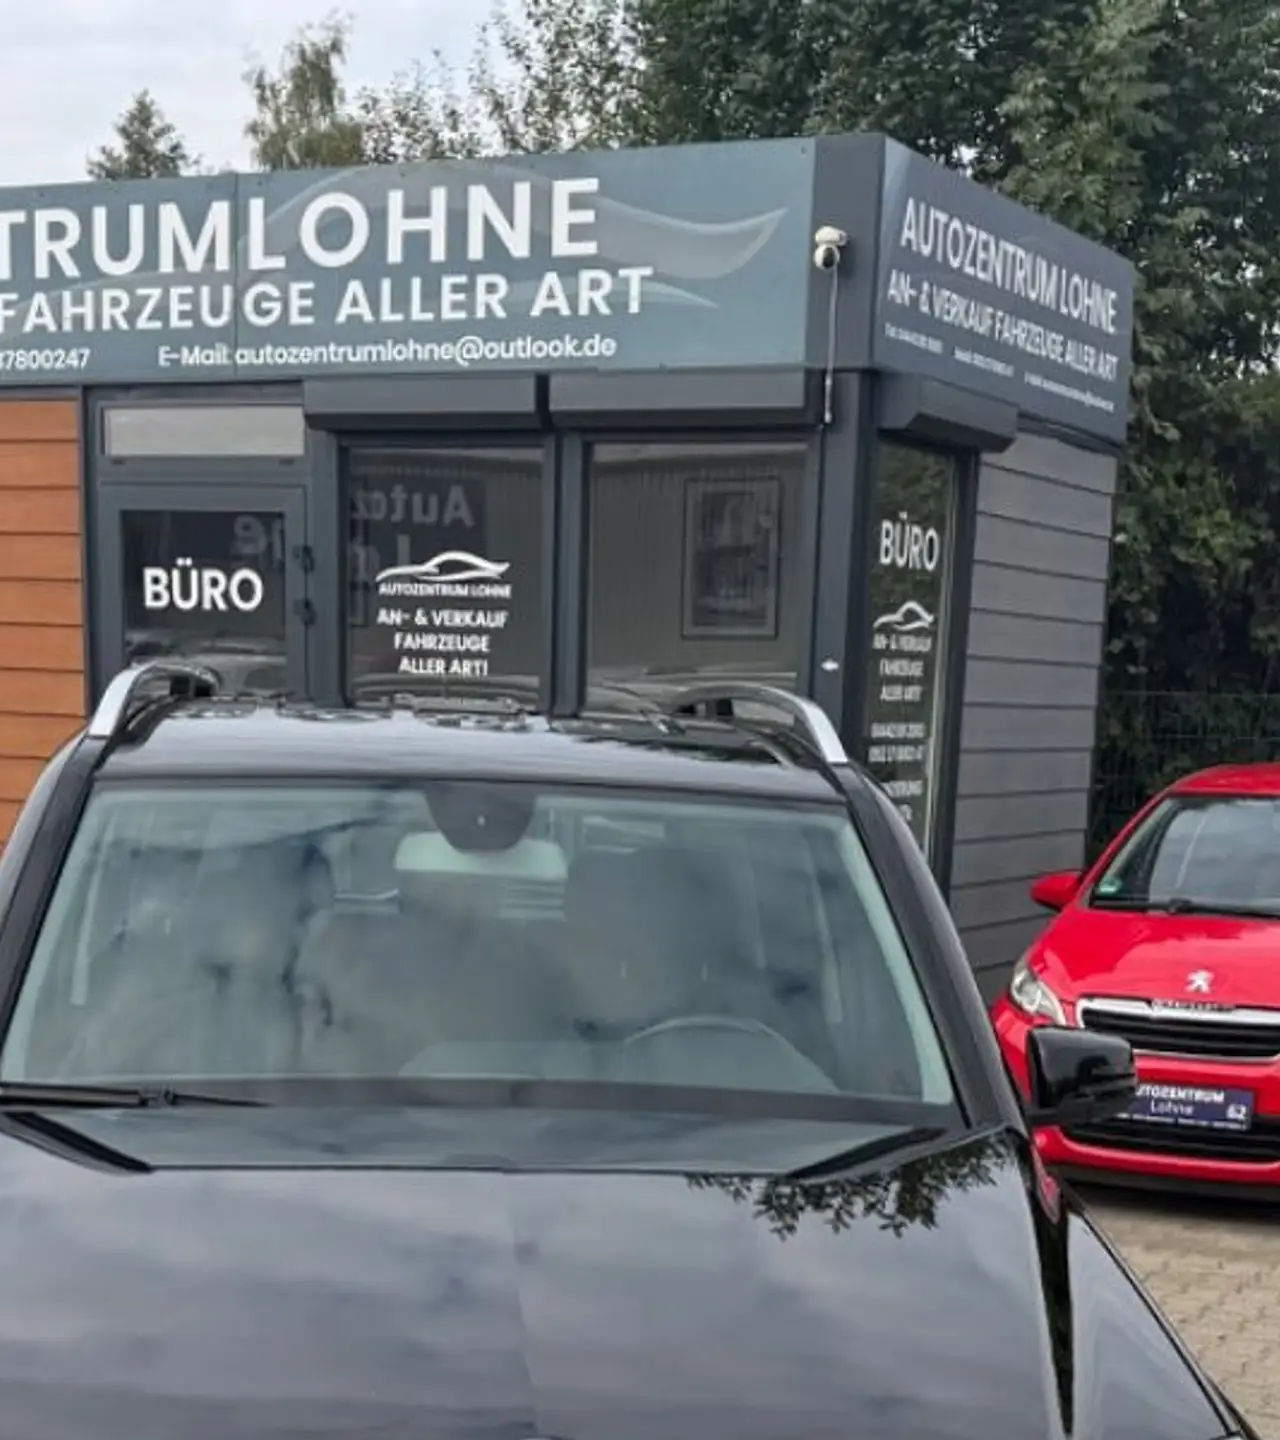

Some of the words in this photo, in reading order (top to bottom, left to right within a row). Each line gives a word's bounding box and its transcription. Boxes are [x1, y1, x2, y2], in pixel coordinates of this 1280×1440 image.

[900, 196, 1058, 311] AUTOZENTRUM
[1059, 267, 1118, 334] LOHNE
[335, 277, 507, 324] ALLER
[531, 267, 653, 317] ART
[235, 334, 617, 367] autozentrumlohne@outlook.de
[879, 511, 940, 571] BÜRO
[144, 557, 264, 612] BÜRO
[377, 608, 410, 626] AN-
[414, 607, 428, 626] &
[431, 609, 508, 628] VERKAUF
[394, 632, 490, 652] FAHRZEUGE
[399, 656, 445, 675] ALLER
